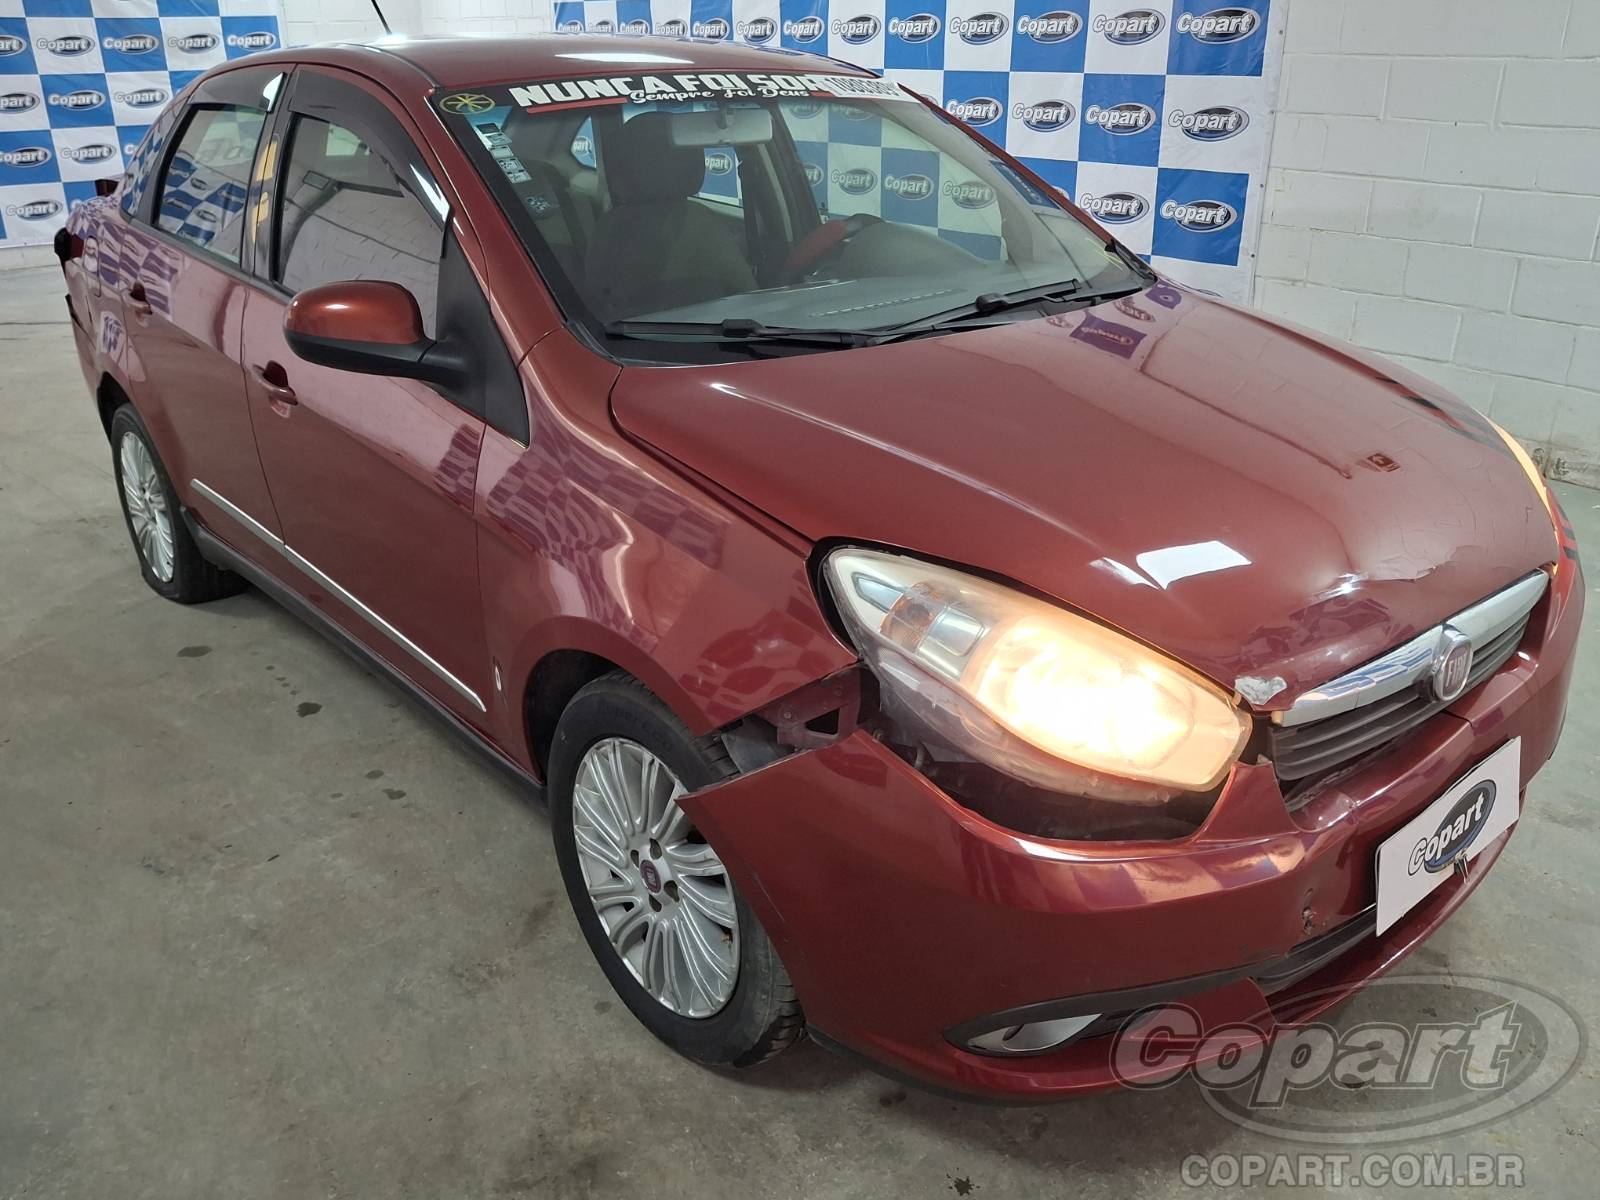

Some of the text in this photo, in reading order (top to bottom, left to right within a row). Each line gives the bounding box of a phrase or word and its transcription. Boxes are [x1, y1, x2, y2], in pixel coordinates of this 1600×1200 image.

[655, 22, 684, 35] Copart
[692, 21, 726, 37] Copart
[737, 21, 771, 38] Copart
[783, 19, 820, 38] Copart
[831, 18, 875, 38] Copart
[888, 17, 934, 38] Copart
[950, 17, 1001, 39] Copart
[1017, 15, 1075, 38] Copart
[1093, 14, 1156, 39] Copart
[1176, 12, 1252, 38] Copart
[0, 38, 19, 51] art
[37, 38, 88, 51] Copart
[103, 37, 152, 51] Copart
[168, 36, 214, 48] Copart
[227, 34, 272, 47] Copart
[48, 93, 100, 107] Copart
[114, 90, 162, 103] Copart
[508, 76, 678, 107] NUNCA
[673, 74, 749, 91] FOI
[757, 85, 810, 98] Deus
[0, 94, 32, 110] part
[946, 99, 997, 120] Copart
[1012, 103, 1067, 125] Copart
[1085, 104, 1146, 127] Copart
[1168, 110, 1240, 133] Copart
[61, 147, 109, 161] Copart
[573, 141, 588, 152] part
[0, 149, 44, 165] opart
[831, 168, 871, 187] Copart
[885, 176, 928, 195] Copart
[943, 181, 992, 202] Copart
[6, 202, 57, 217] Copart
[1080, 193, 1140, 218] Copart
[1161, 200, 1228, 224] Copart
[1445, 652, 1467, 688] FIAT
[1407, 791, 1487, 876] Copart
